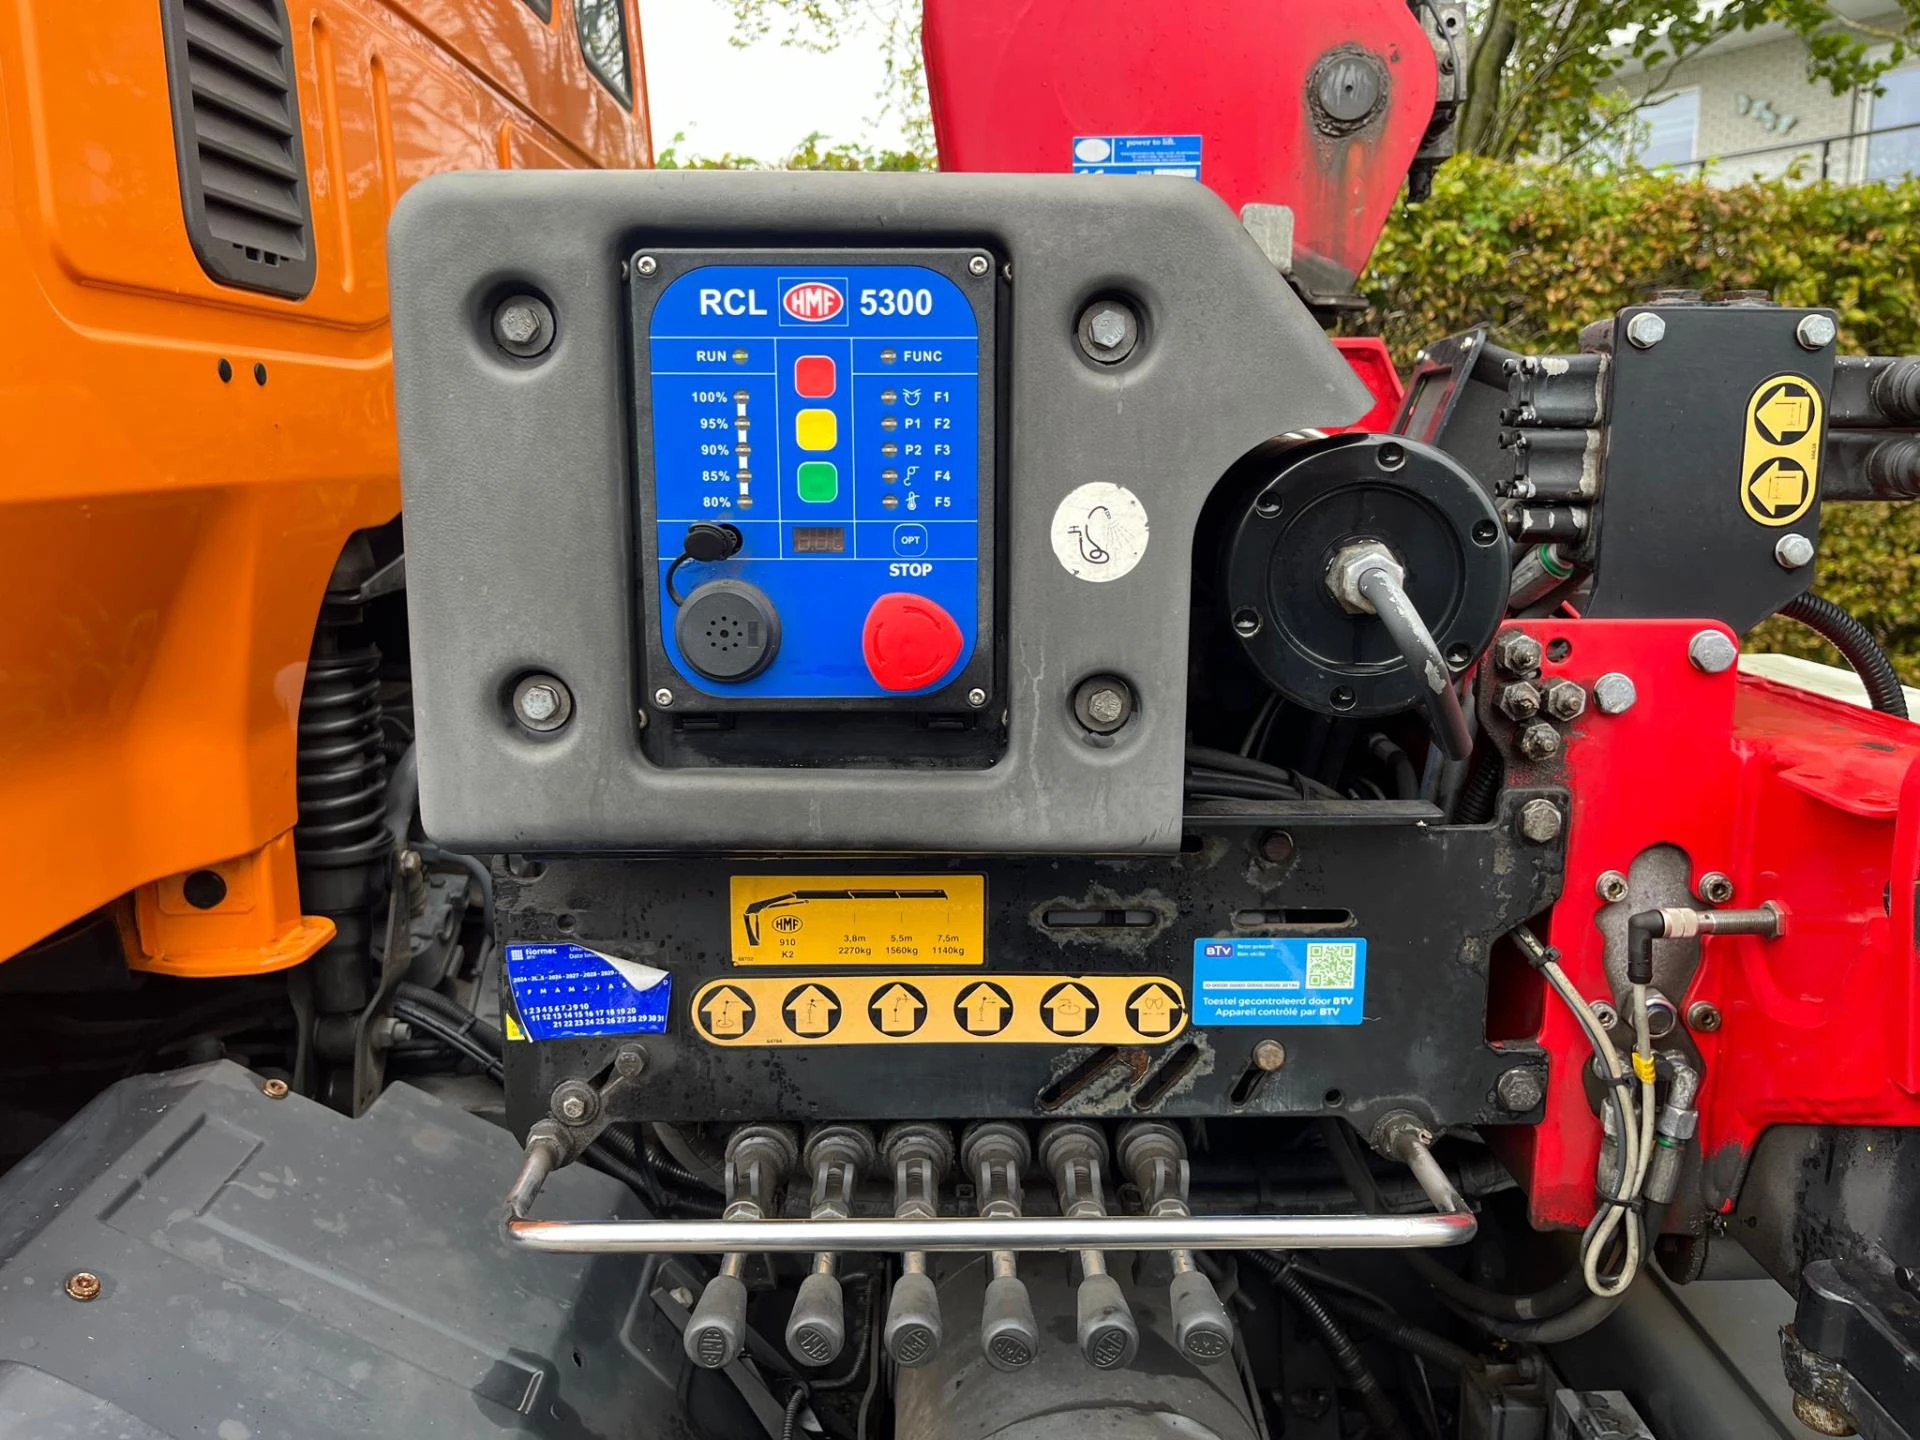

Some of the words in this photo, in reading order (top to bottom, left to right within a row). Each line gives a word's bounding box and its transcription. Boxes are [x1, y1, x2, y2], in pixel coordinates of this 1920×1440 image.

[700, 289, 767, 315] RCL
[792, 289, 835, 315] HMF
[860, 289, 933, 315] 5300
[697, 351, 727, 362] RUN
[904, 351, 942, 362] FUNC
[692, 392, 728, 403] 100%
[934, 392, 950, 402] F1
[700, 418, 728, 429] 95%
[905, 418, 921, 429] P1
[934, 418, 950, 429] F2
[701, 445, 729, 456] 90%
[905, 445, 921, 455] P2
[934, 445, 950, 455] F3
[702, 471, 730, 481] 85%
[934, 471, 950, 481] F4
[703, 497, 731, 508] 80%
[935, 497, 951, 507] F5
[901, 536, 920, 545] OPT
[889, 563, 933, 577] STOP
[776, 917, 799, 931] HMF
[780, 938, 796, 946] 910
[844, 934, 866, 943] 3,8m
[890, 934, 912, 943] 5,5m
[937, 934, 959, 943] 7,5m
[838, 947, 871, 956] 2270kg
[885, 947, 918, 956] 1560kg
[932, 947, 964, 956] 1140kg
[1206, 945, 1231, 956] BTV
[1203, 997, 1236, 1005] Toestel
[1239, 997, 1305, 1007] gecontroleerd
[1308, 997, 1330, 1005] door
[1333, 997, 1353, 1005] BTV
[1216, 1007, 1256, 1017] Appareil
[1258, 1007, 1297, 1016] contrôlé
[1301, 1009, 1316, 1017] par
[1320, 1007, 1339, 1016] BTV
